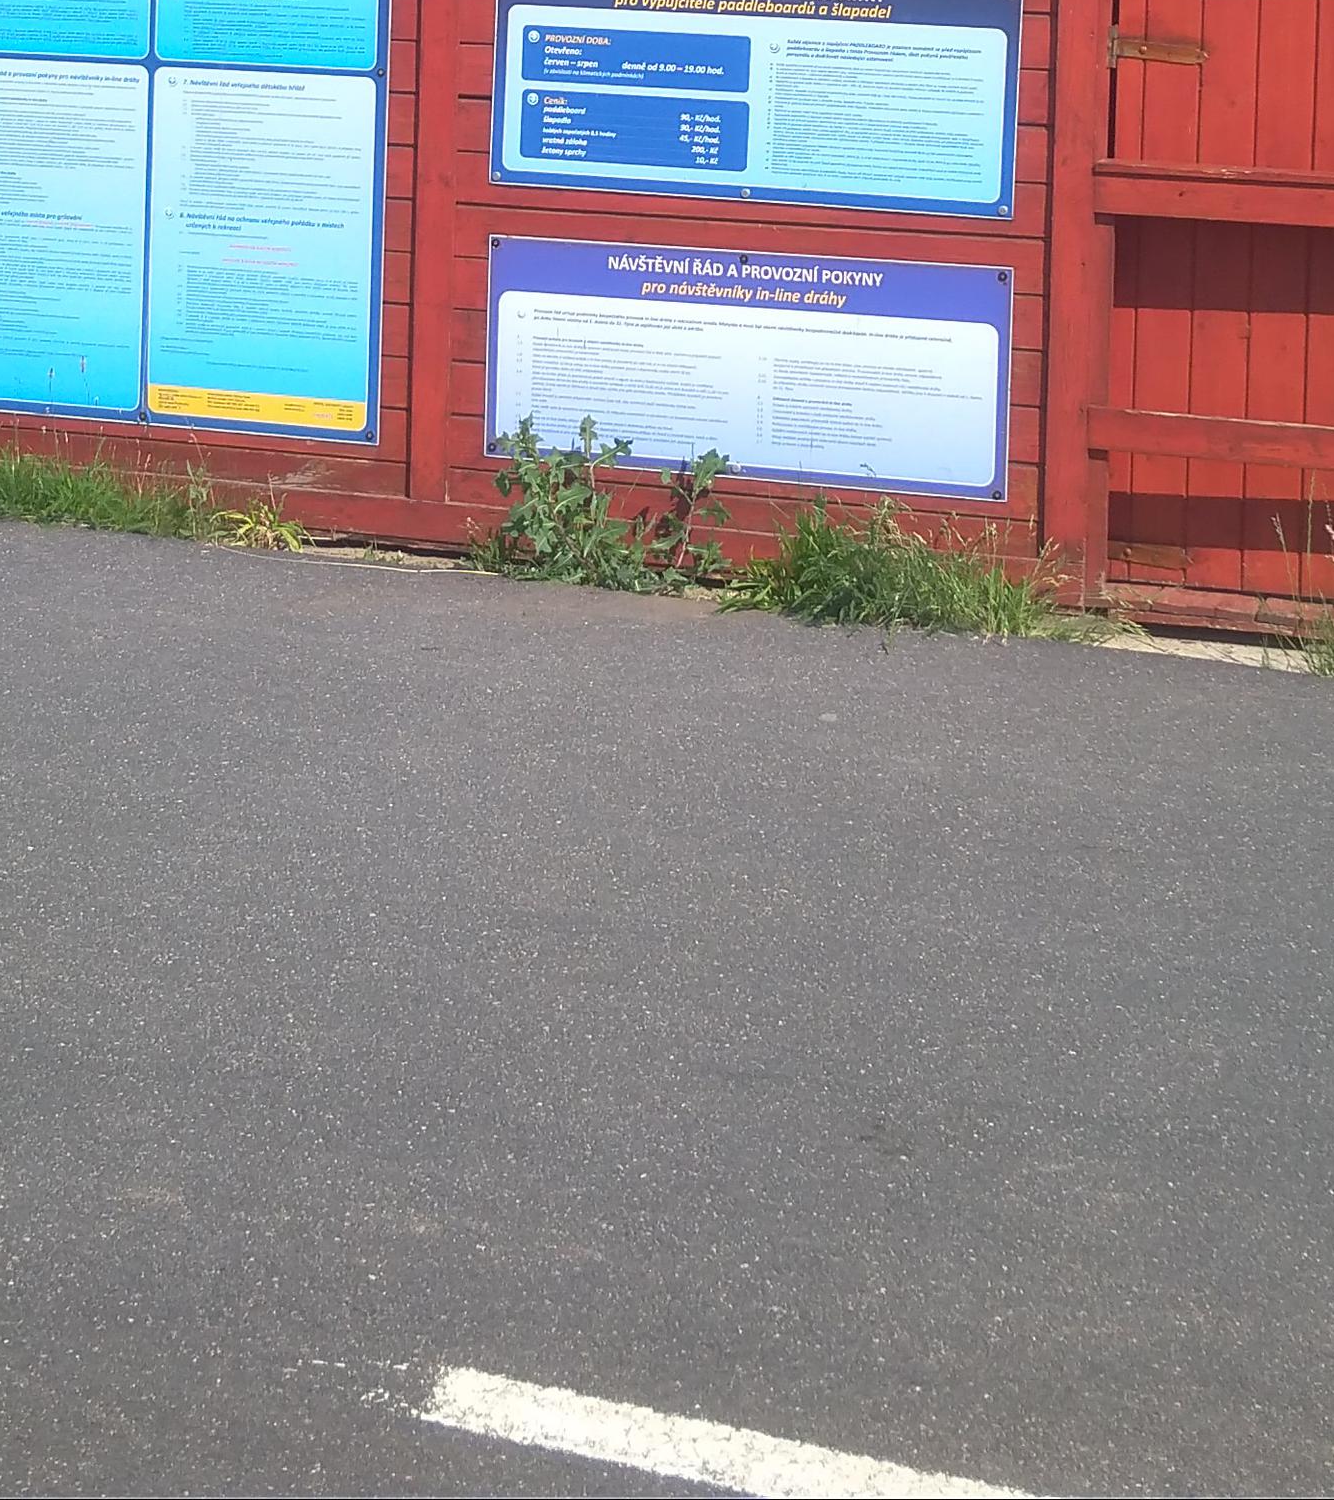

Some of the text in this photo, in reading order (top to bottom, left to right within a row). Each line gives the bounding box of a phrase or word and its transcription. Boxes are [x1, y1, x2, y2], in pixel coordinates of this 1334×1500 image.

[818, 5, 828, 15] a
[830, 3, 892, 20] šlapadel
[544, 34, 612, 46] PROVOZNÍ DOBA:
[544, 45, 583, 56] Otevřeno:
[543, 57, 569, 67] červen
[576, 59, 599, 69] srpen
[622, 61, 647, 72] denně
[647, 62, 658, 72] od
[658, 63, 676, 73] 9.00
[683, 64, 706, 74] 19.00
[706, 65, 725, 75] hod.
[608, 254, 883, 287] NÁVŠTĚVNÍ ŘÁD A PROVOZNÍ POKYNY
[641, 281, 846, 309] pro návštěvníky in-line dráhy
